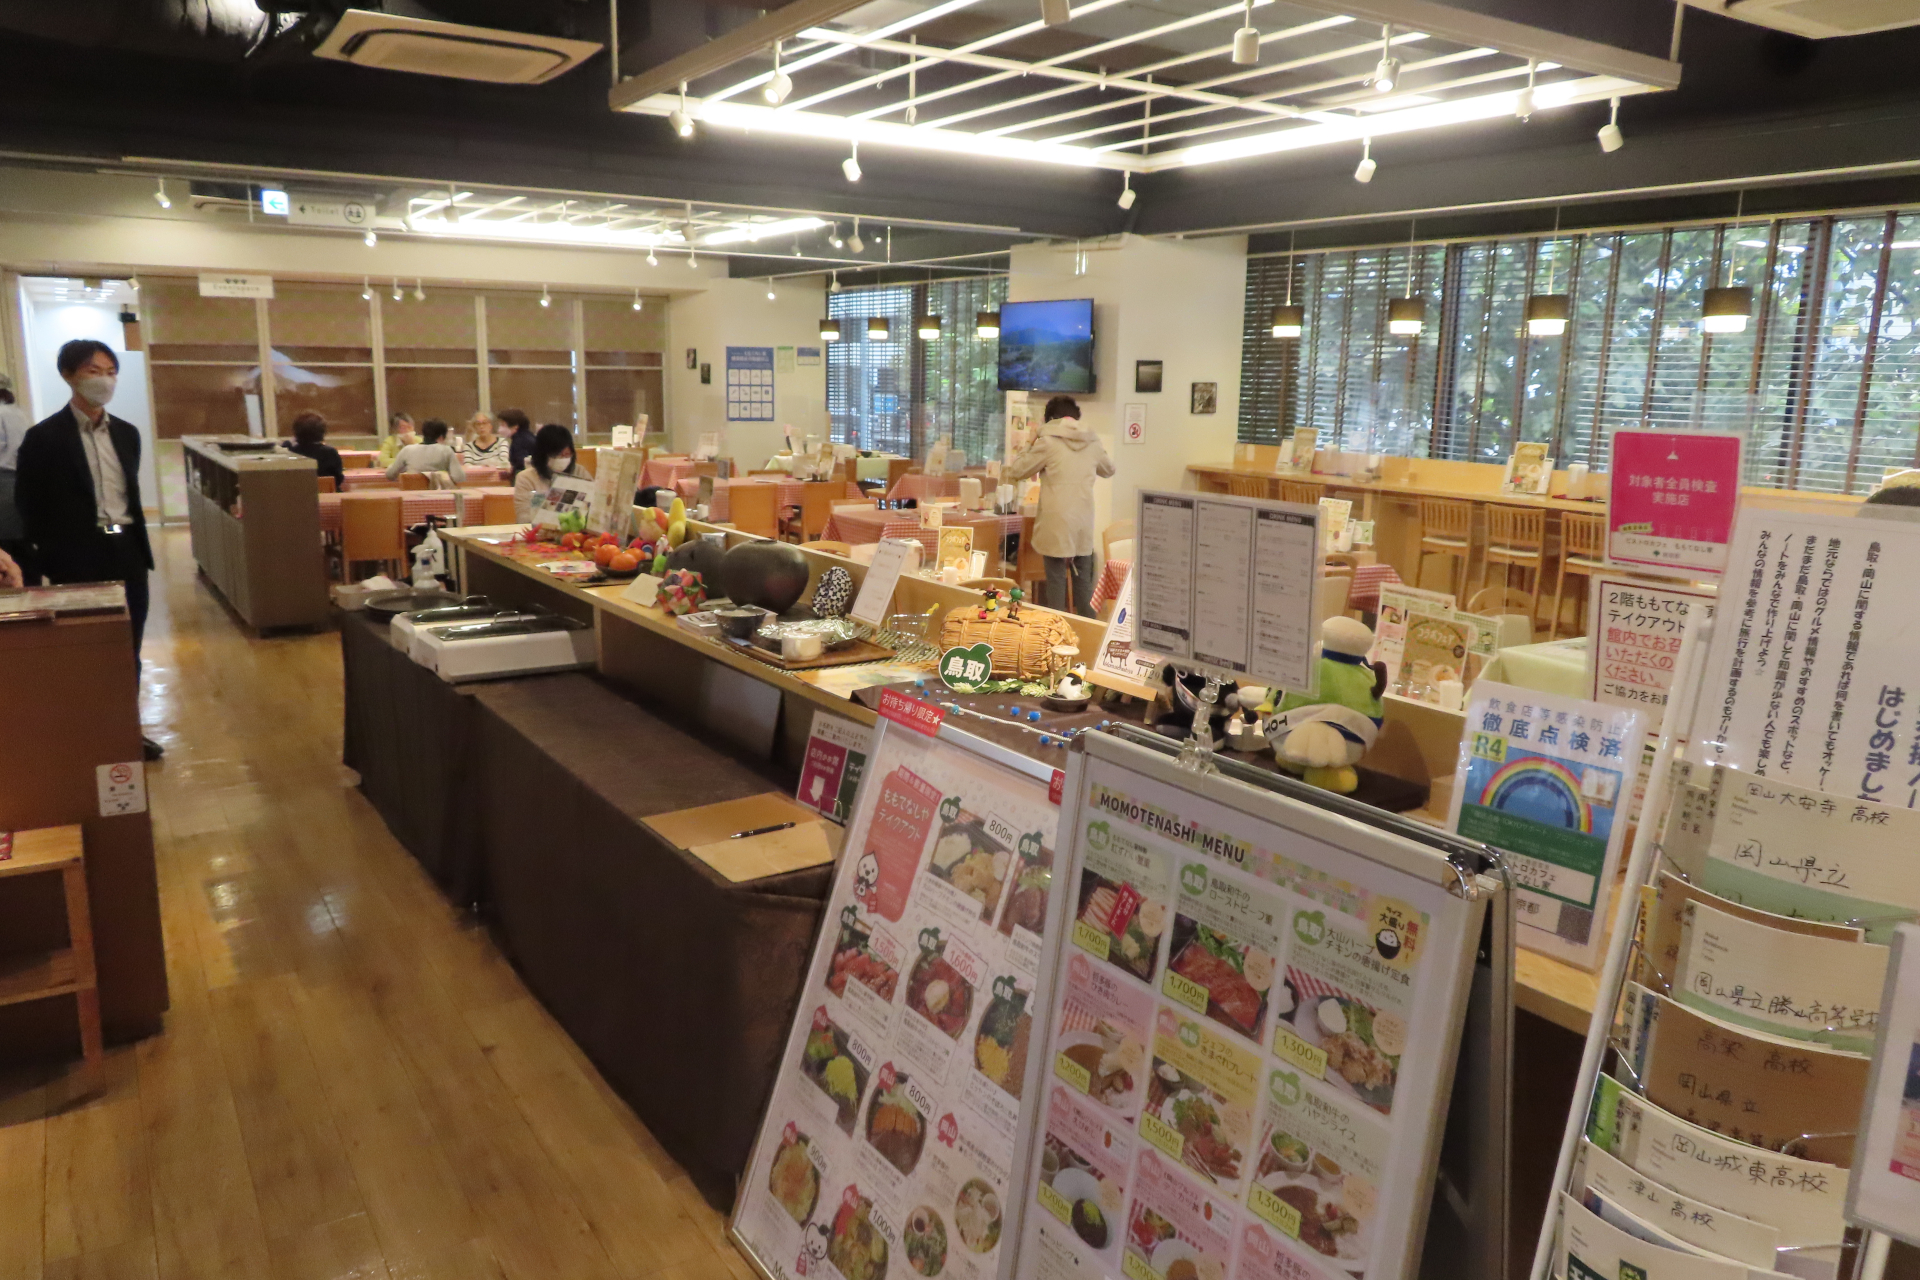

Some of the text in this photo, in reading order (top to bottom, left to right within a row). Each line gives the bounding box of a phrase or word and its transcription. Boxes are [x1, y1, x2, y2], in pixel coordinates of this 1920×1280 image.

[1629, 475, 1718, 493] 対象者全員検査
[1652, 491, 1690, 506] 実施店
[944, 656, 985, 682] 鳥取
[1474, 737, 1502, 757] R4
[1482, 711, 1622, 758] 徹底点検済
[884, 788, 930, 821] ももてなしや
[940, 803, 958, 820] 鳥取
[1851, 805, 1890, 827] 高校
[878, 809, 921, 842] テイクアウト
[989, 819, 1013, 844] 800円
[1100, 792, 1245, 863] MOMOTENASHI MENU
[1020, 838, 1040, 858] 鳥取
[1734, 839, 1850, 890] 岡山県立
[1379, 913, 1405, 931] 大盛り
[874, 937, 899, 969] 1,500円
[1078, 926, 1107, 951] 1,700円
[950, 950, 978, 984] 1,600円
[1326, 940, 1411, 987] チキンの唐揚げ定食
[1169, 975, 1205, 1003] 1,700円
[851, 1040, 872, 1067] 800円
[1281, 1035, 1323, 1067] 1,300円
[1763, 1050, 1815, 1077] 高校
[1058, 1056, 1088, 1082] 1,200円
[908, 1085, 932, 1115] 800円
[1145, 1118, 1180, 1148] 1,500円
[1302, 1106, 1357, 1143] ハヤシライス
[1671, 1133, 1829, 1195] 岡山城東高校
[1256, 1190, 1297, 1224] 1,300円
[1627, 1178, 1717, 1233] 津山 高校
[872, 1209, 897, 1246] 1,000円
